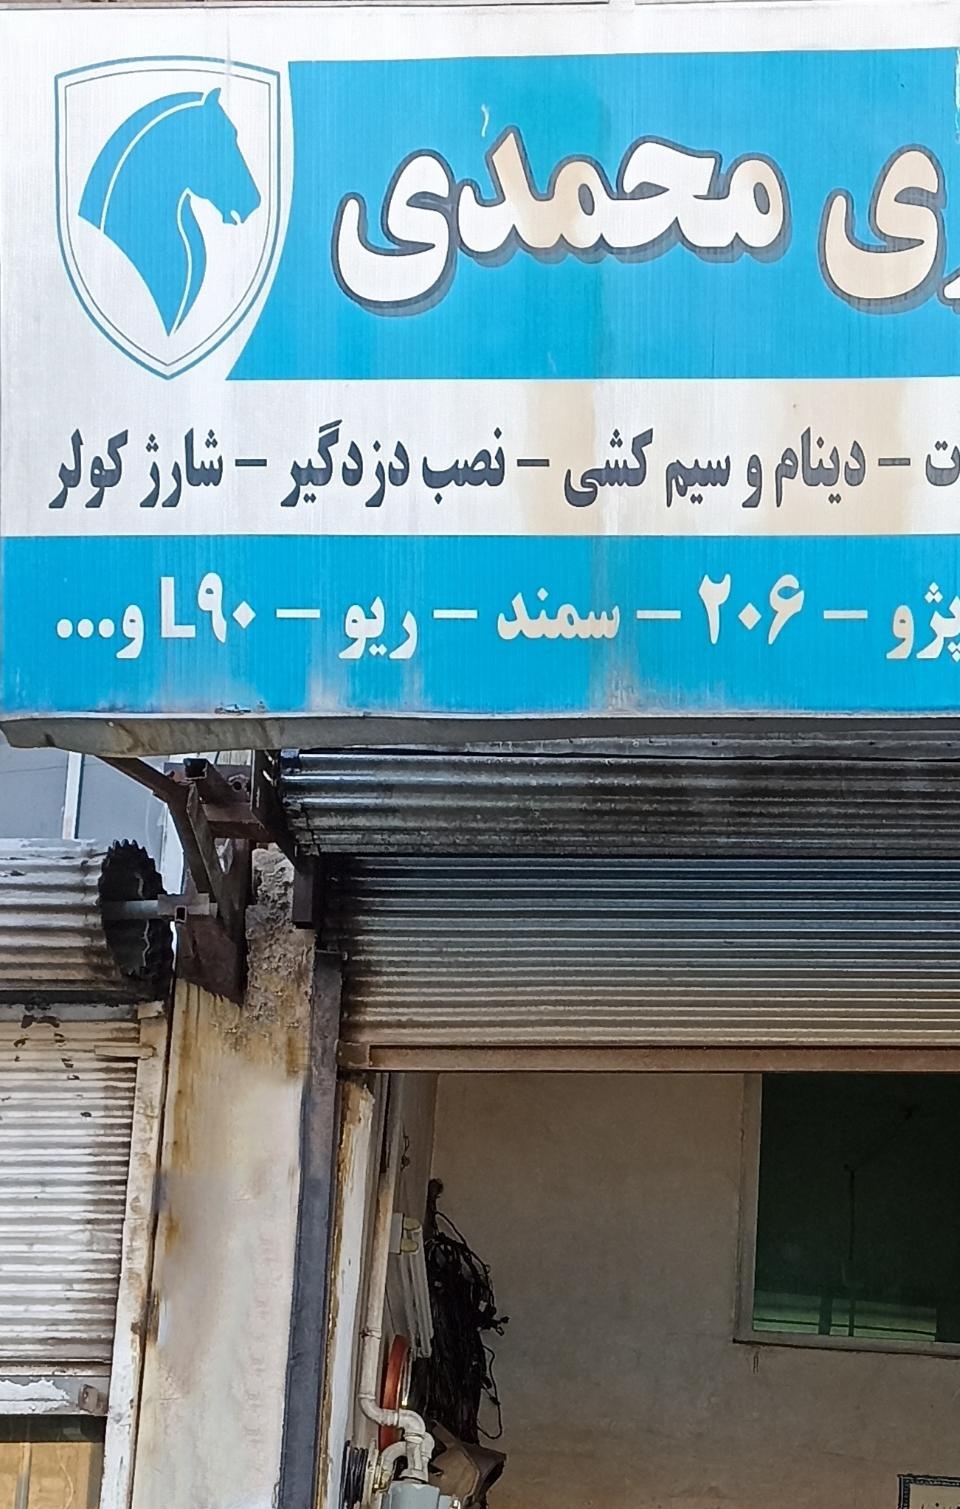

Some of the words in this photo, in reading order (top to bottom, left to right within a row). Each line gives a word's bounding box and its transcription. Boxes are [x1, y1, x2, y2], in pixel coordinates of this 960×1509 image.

[332, 126, 788, 308] محمدی
[48, 428, 130, 510] کولر
[139, 427, 225, 509] شارژ
[280, 419, 411, 509] دزدگیر
[422, 426, 506, 506] نصب
[563, 427, 655, 509] کشی
[665, 454, 732, 509] سیم
[741, 454, 764, 509] و
[774, 427, 867, 509] دینام
[338, 597, 419, 661] ریو
[497, 588, 621, 641] سمند
[698, 574, 805, 645] ۲۰۶
